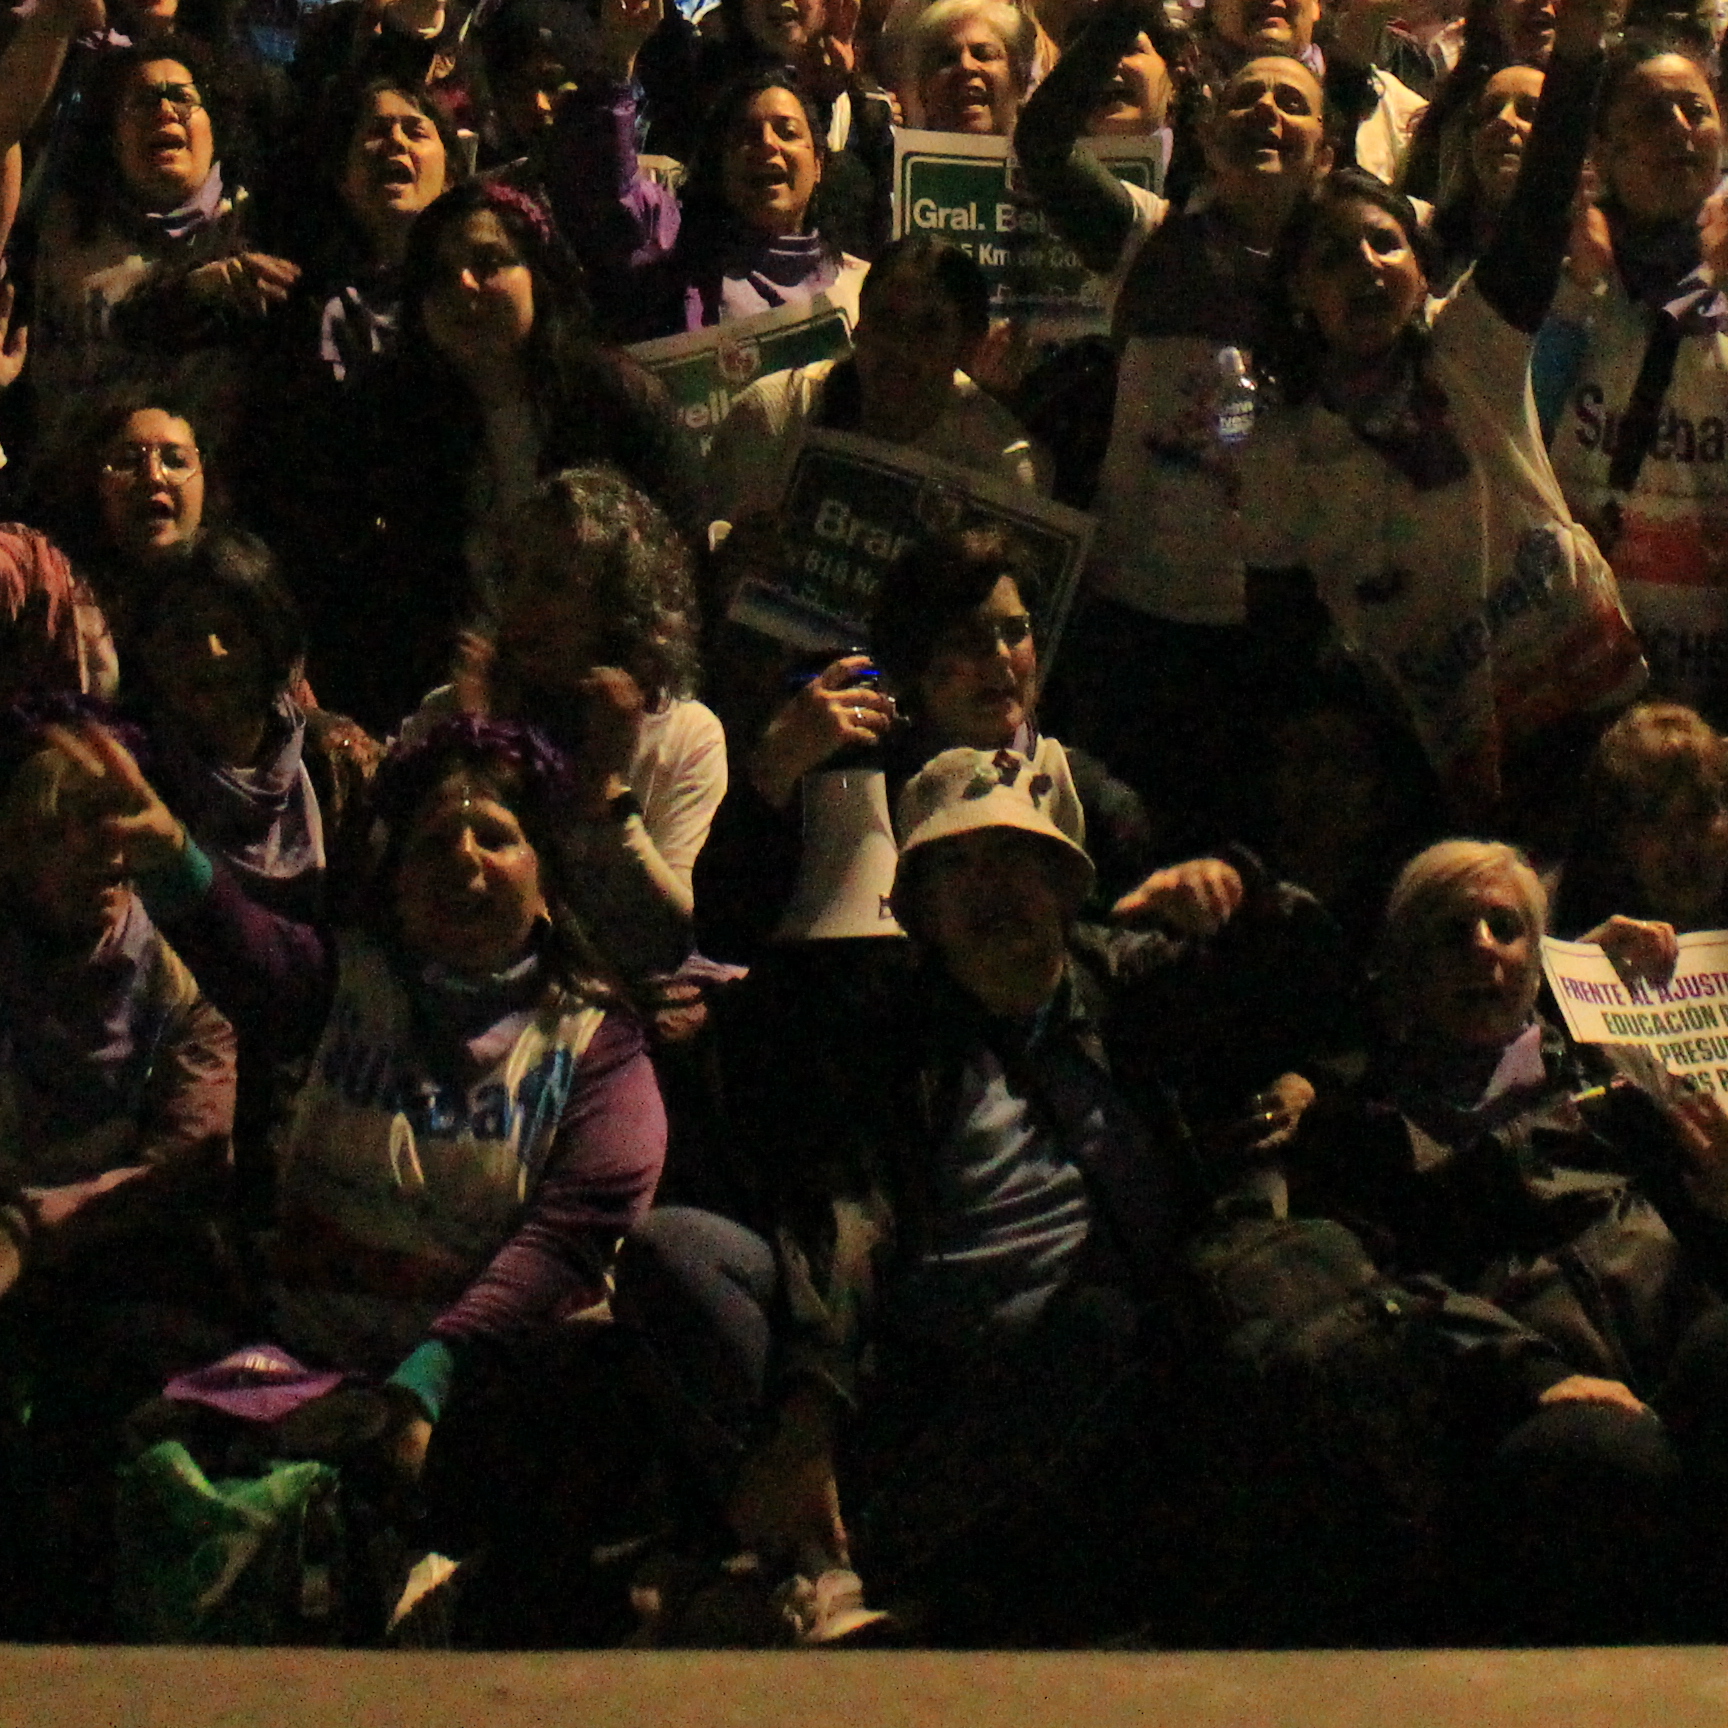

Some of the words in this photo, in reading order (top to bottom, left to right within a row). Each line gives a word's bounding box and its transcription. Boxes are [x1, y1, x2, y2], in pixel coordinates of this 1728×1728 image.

[912, 197, 986, 232] Gral.
[1559, 975, 1626, 1006] FRENTE
[1600, 1002, 1720, 1038] EDUCACIÓN
